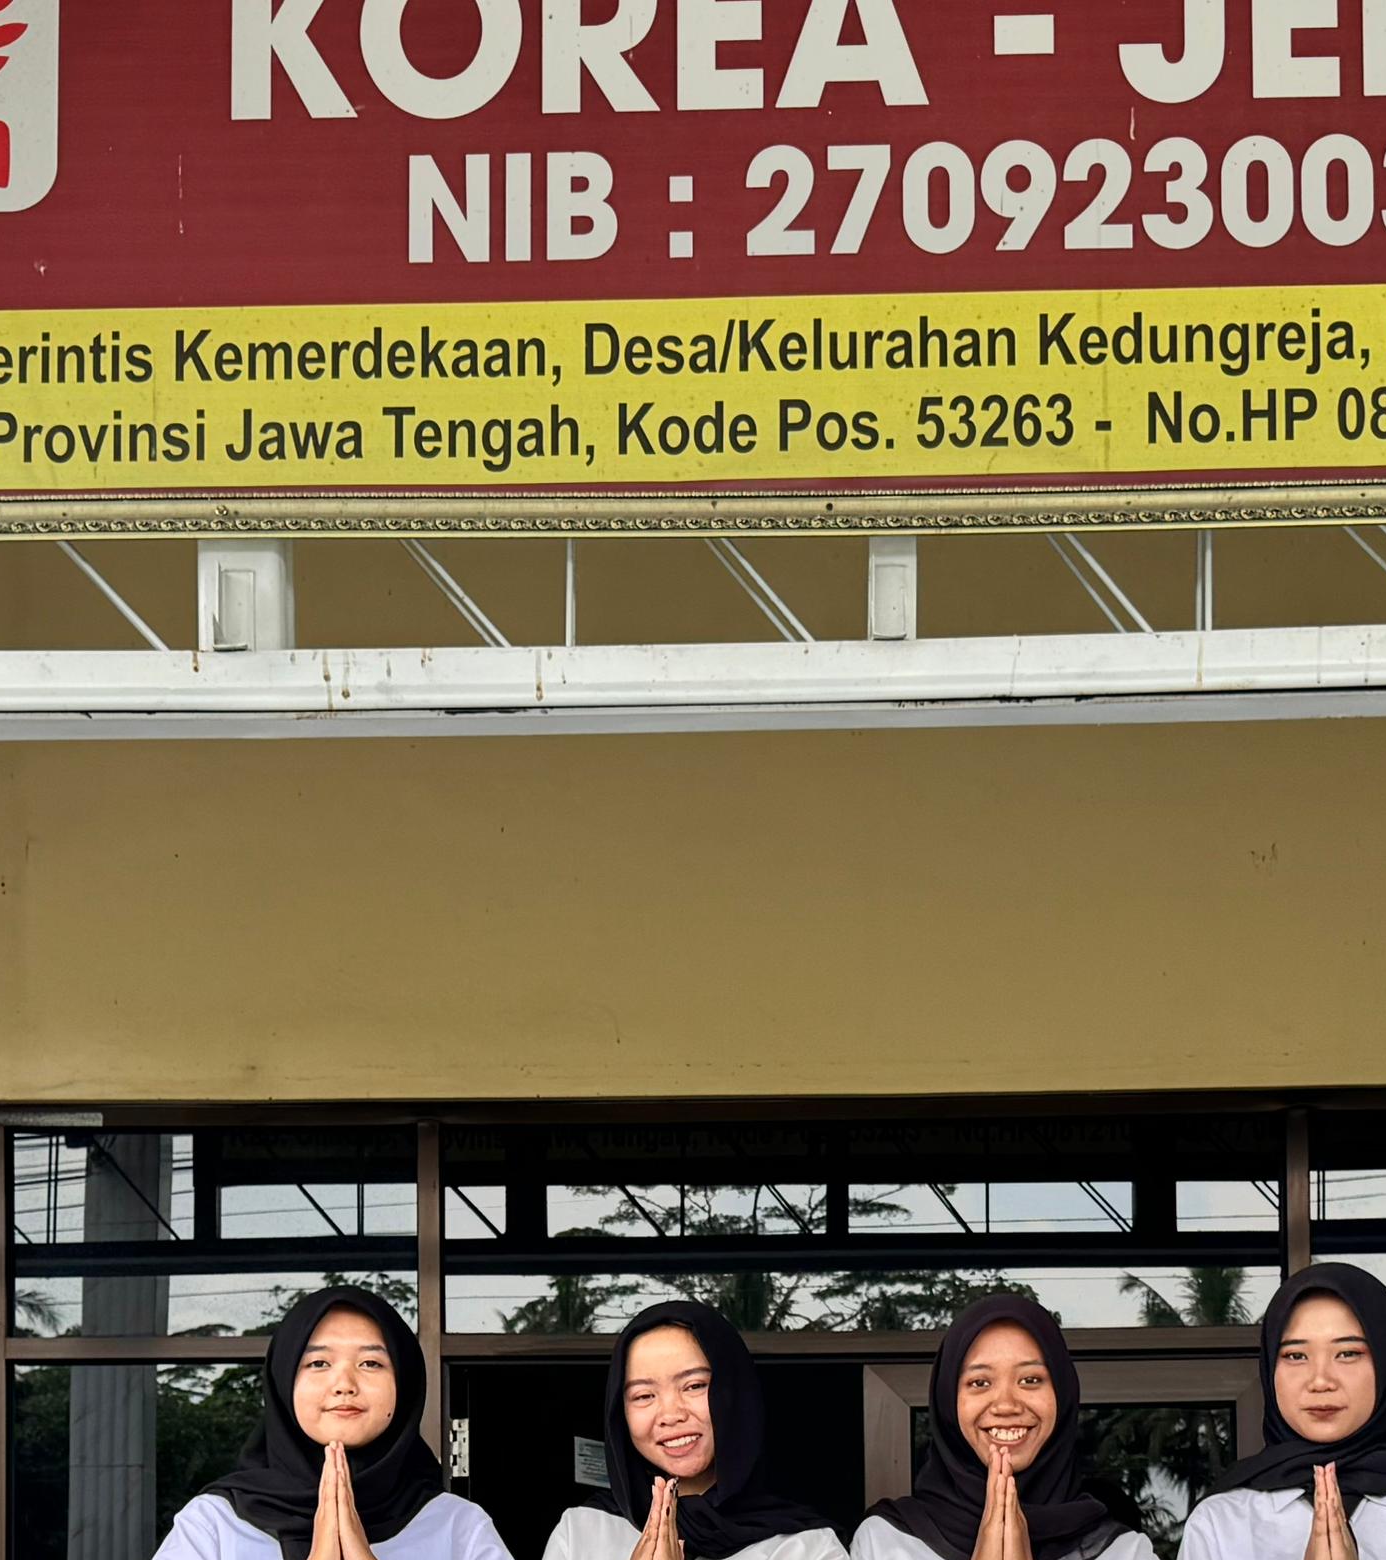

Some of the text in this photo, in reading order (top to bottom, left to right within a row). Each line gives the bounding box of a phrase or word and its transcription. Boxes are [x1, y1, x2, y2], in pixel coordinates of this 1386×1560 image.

[231, 0, 929, 120] KOREA
[994, 15, 1054, 55] -
[409, 152, 617, 263] NIB
[176, 326, 562, 386] Kemerdekaan,
[585, 316, 1015, 374] Desa/Kelurahan
[1040, 308, 1370, 376] Kedungreja,
[226, 409, 362, 461] Jawa
[383, 405, 595, 472] Tengah,
[619, 401, 757, 455] Kode
[780, 399, 895, 451] Pos.
[917, 394, 1074, 449] 53263
[1148, 389, 1317, 443] No.HP
